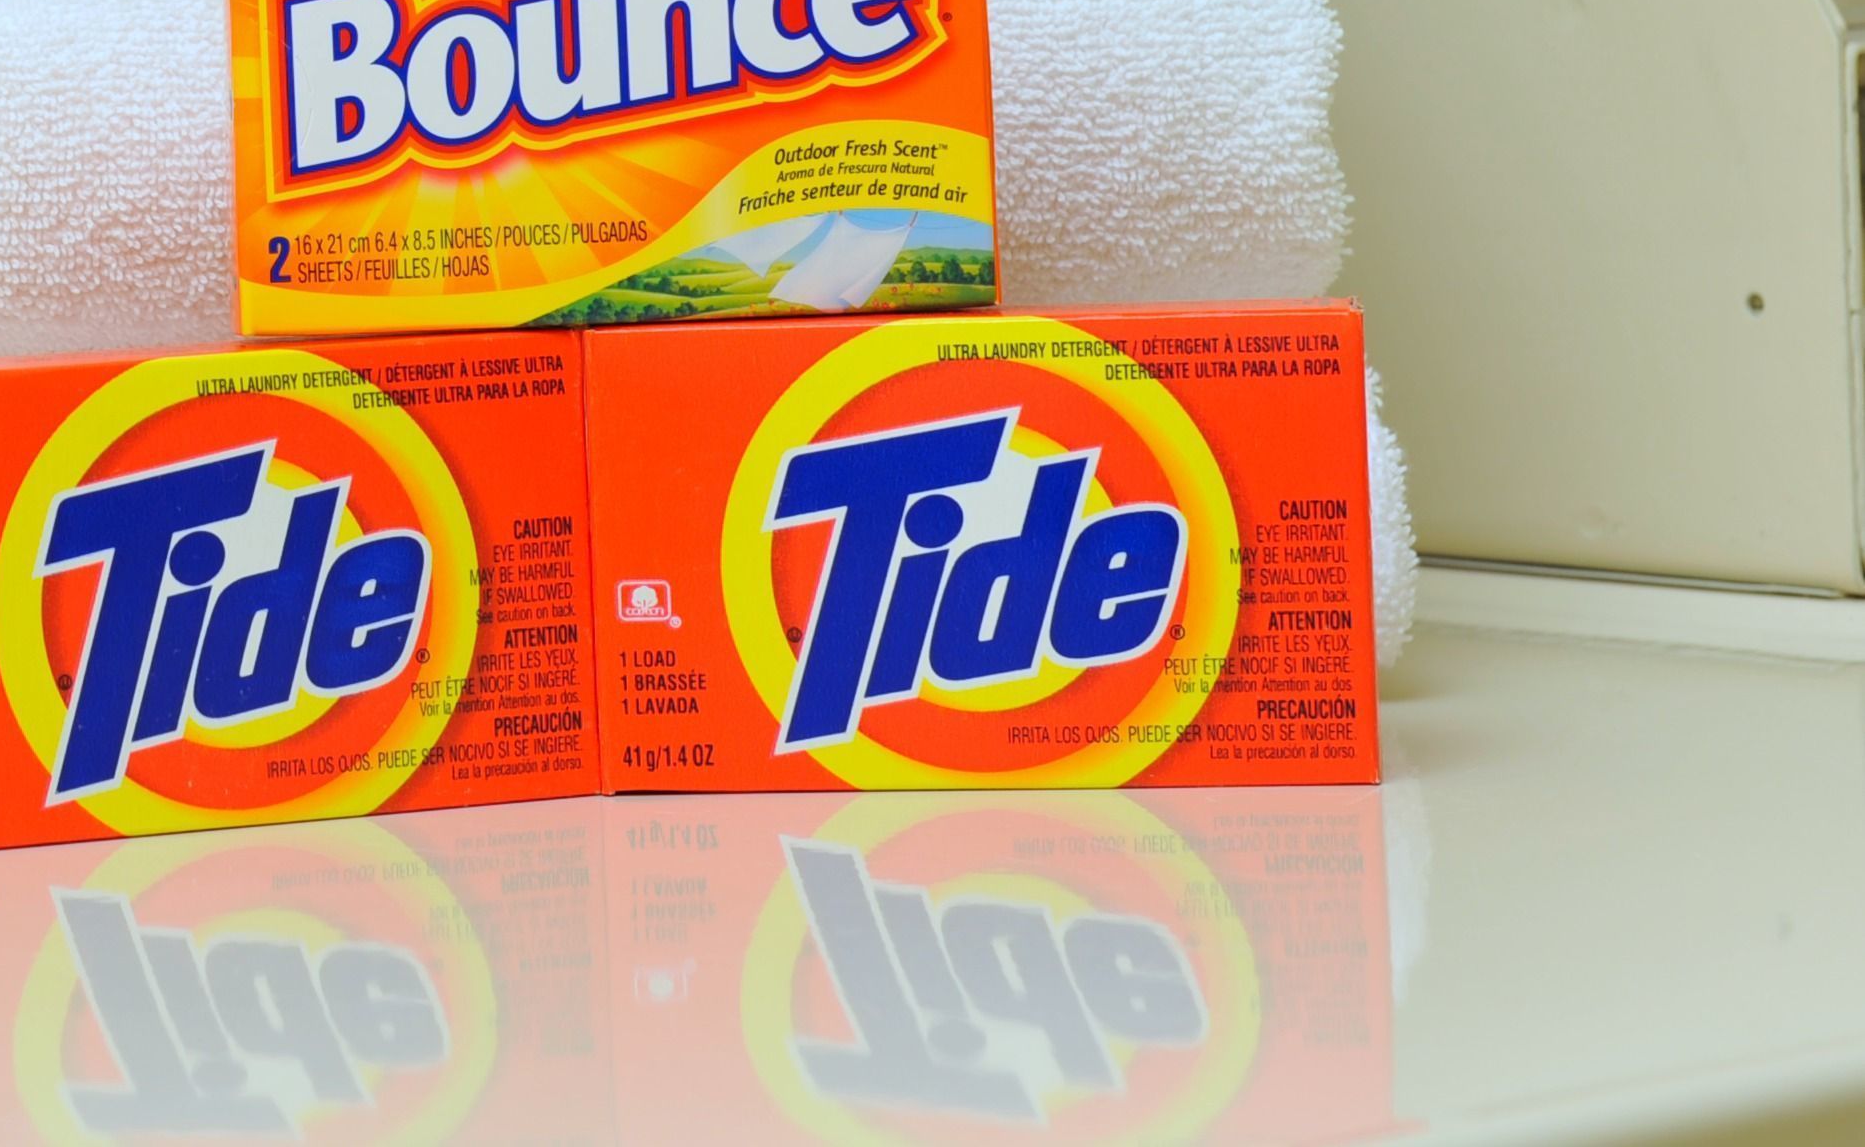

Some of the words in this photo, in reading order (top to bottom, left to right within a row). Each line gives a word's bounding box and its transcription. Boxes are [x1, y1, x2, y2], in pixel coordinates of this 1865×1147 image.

[774, 143, 839, 165] Outdoor
[845, 140, 887, 156] Fresh
[777, 169, 814, 183] Aroma
[818, 164, 833, 177] de
[838, 162, 887, 175] Frescura
[891, 162, 935, 176] Natural
[738, 189, 795, 214] Fraîche
[801, 182, 863, 201] senteur
[868, 179, 887, 196] de
[893, 183, 940, 201] grand
[944, 186, 968, 203] air
[295, 235, 312, 255] 16
[315, 238, 324, 254] x
[327, 233, 344, 254] 21
[349, 236, 370, 253] cm
[375, 231, 398, 252] 6.4
[401, 235, 409, 251] x
[413, 229, 436, 251] 8.5
[439, 227, 493, 249] INCHES
[268, 236, 292, 283] 2
[297, 260, 354, 284] SHEETS
[364, 258, 430, 281] FEUILLES
[441, 255, 490, 278] HOJAS
[937, 345, 979, 362] ULTRA
[984, 343, 1046, 360] LAUNDRY
[1051, 341, 1127, 358] DETERGENT
[1238, 336, 1293, 353] LESSIVE
[1297, 335, 1339, 351] ULTRA
[196, 379, 235, 397] ULTRA
[239, 375, 297, 394] LAUNDRY
[303, 369, 373, 389] DETERGENT
[471, 358, 520, 377] LESSIVE
[524, 355, 564, 373] ULTRA
[1105, 363, 1191, 381] DETERGENTE
[1195, 362, 1237, 378] ULTRA
[1242, 360, 1278, 377] PARA
[1281, 360, 1299, 376] LA
[1304, 359, 1341, 375] ROPA
[353, 389, 431, 409] DETERGENTE
[434, 384, 473, 402] ULTRA
[477, 382, 510, 399] PARA
[513, 381, 529, 397] LA
[532, 378, 565, 395] ROPA
[1280, 500, 1347, 520] CAUTION
[514, 516, 572, 539] CAUTION
[1256, 525, 1280, 542] EYE
[1230, 547, 1258, 564] MAY
[1263, 546, 1279, 564] BE
[1284, 546, 1349, 563] HARMFUL
[761, 404, 1189, 757] Tide
[1244, 568, 1256, 585] IF
[32, 438, 431, 808] Tide
[1268, 610, 1352, 631] ATTENTION
[504, 624, 578, 649] ATTENTION
[1238, 635, 1281, 653] IRRITE
[1286, 635, 1309, 652] LES
[620, 652, 627, 668] 1
[633, 651, 676, 667] LOAD
[1164, 658, 1197, 676] PEUT
[1240, 656, 1279, 674] NOCIF
[1285, 656, 1296, 674] SI
[621, 675, 628, 691] 1
[634, 669, 707, 691] BRASSÉE
[622, 699, 629, 714] 1
[636, 698, 699, 715] LAVADA
[1257, 694, 1355, 719] PRECAUCIÓN
[494, 708, 582, 737] PRECAUCIÓN
[1008, 726, 1050, 745] IRRITA
[1055, 726, 1081, 744] LOS
[1128, 725, 1171, 743] PUEDE
[1176, 724, 1202, 742] SER
[1208, 724, 1256, 742] NOCIVO
[1262, 723, 1275, 741] SI
[1279, 723, 1296, 741] SE
[267, 759, 306, 779] IRRITA
[311, 756, 334, 775] LOS
[378, 749, 417, 769] PUEDE
[422, 746, 445, 766] SER
[450, 742, 494, 762] NOCIVO
[498, 740, 511, 758] SI
[514, 738, 529, 757] SE
[693, 744, 714, 767] OZ
